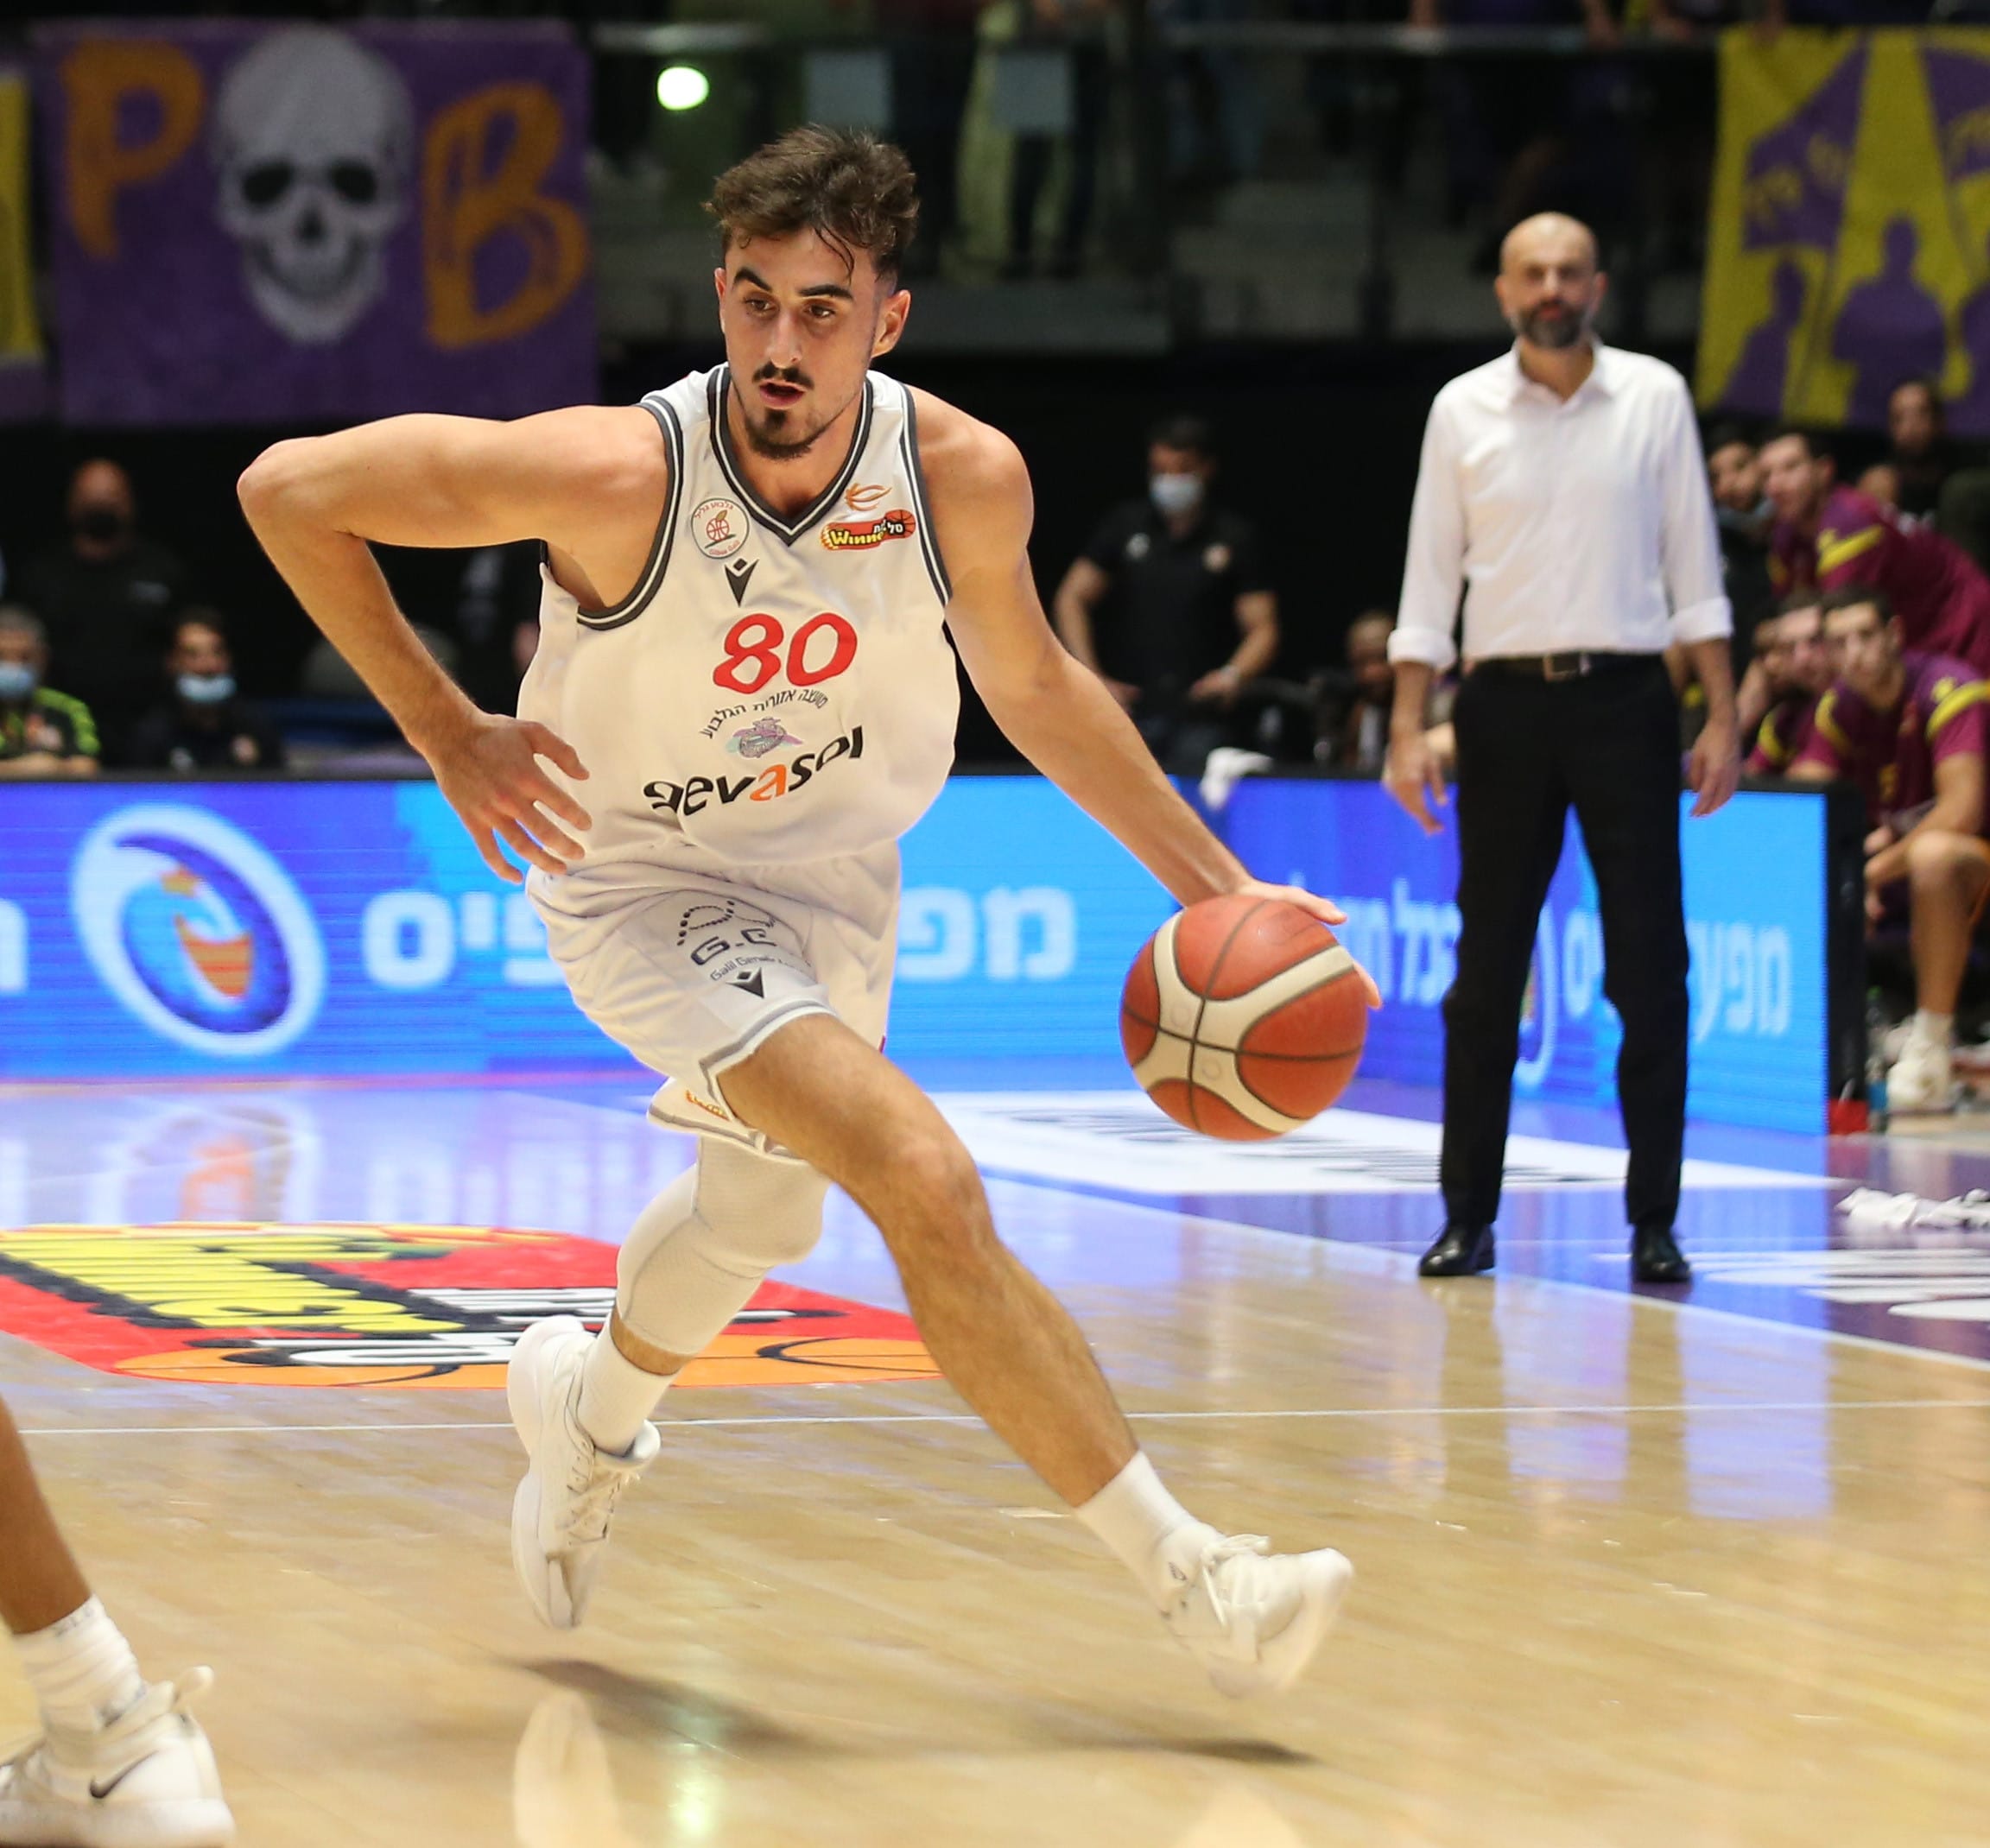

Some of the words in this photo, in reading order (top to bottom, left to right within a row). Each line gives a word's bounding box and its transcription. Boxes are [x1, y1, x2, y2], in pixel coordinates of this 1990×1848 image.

[830, 529, 884, 545] Winne
[713, 612, 858, 694] 80
[700, 704, 746, 739] הגלבוע
[752, 689, 796, 712] אזורית
[643, 725, 863, 816] gevasol
[897, 886, 1075, 980] מפ
[710, 960, 738, 981] Galil
[1687, 919, 1792, 1047] מפע
